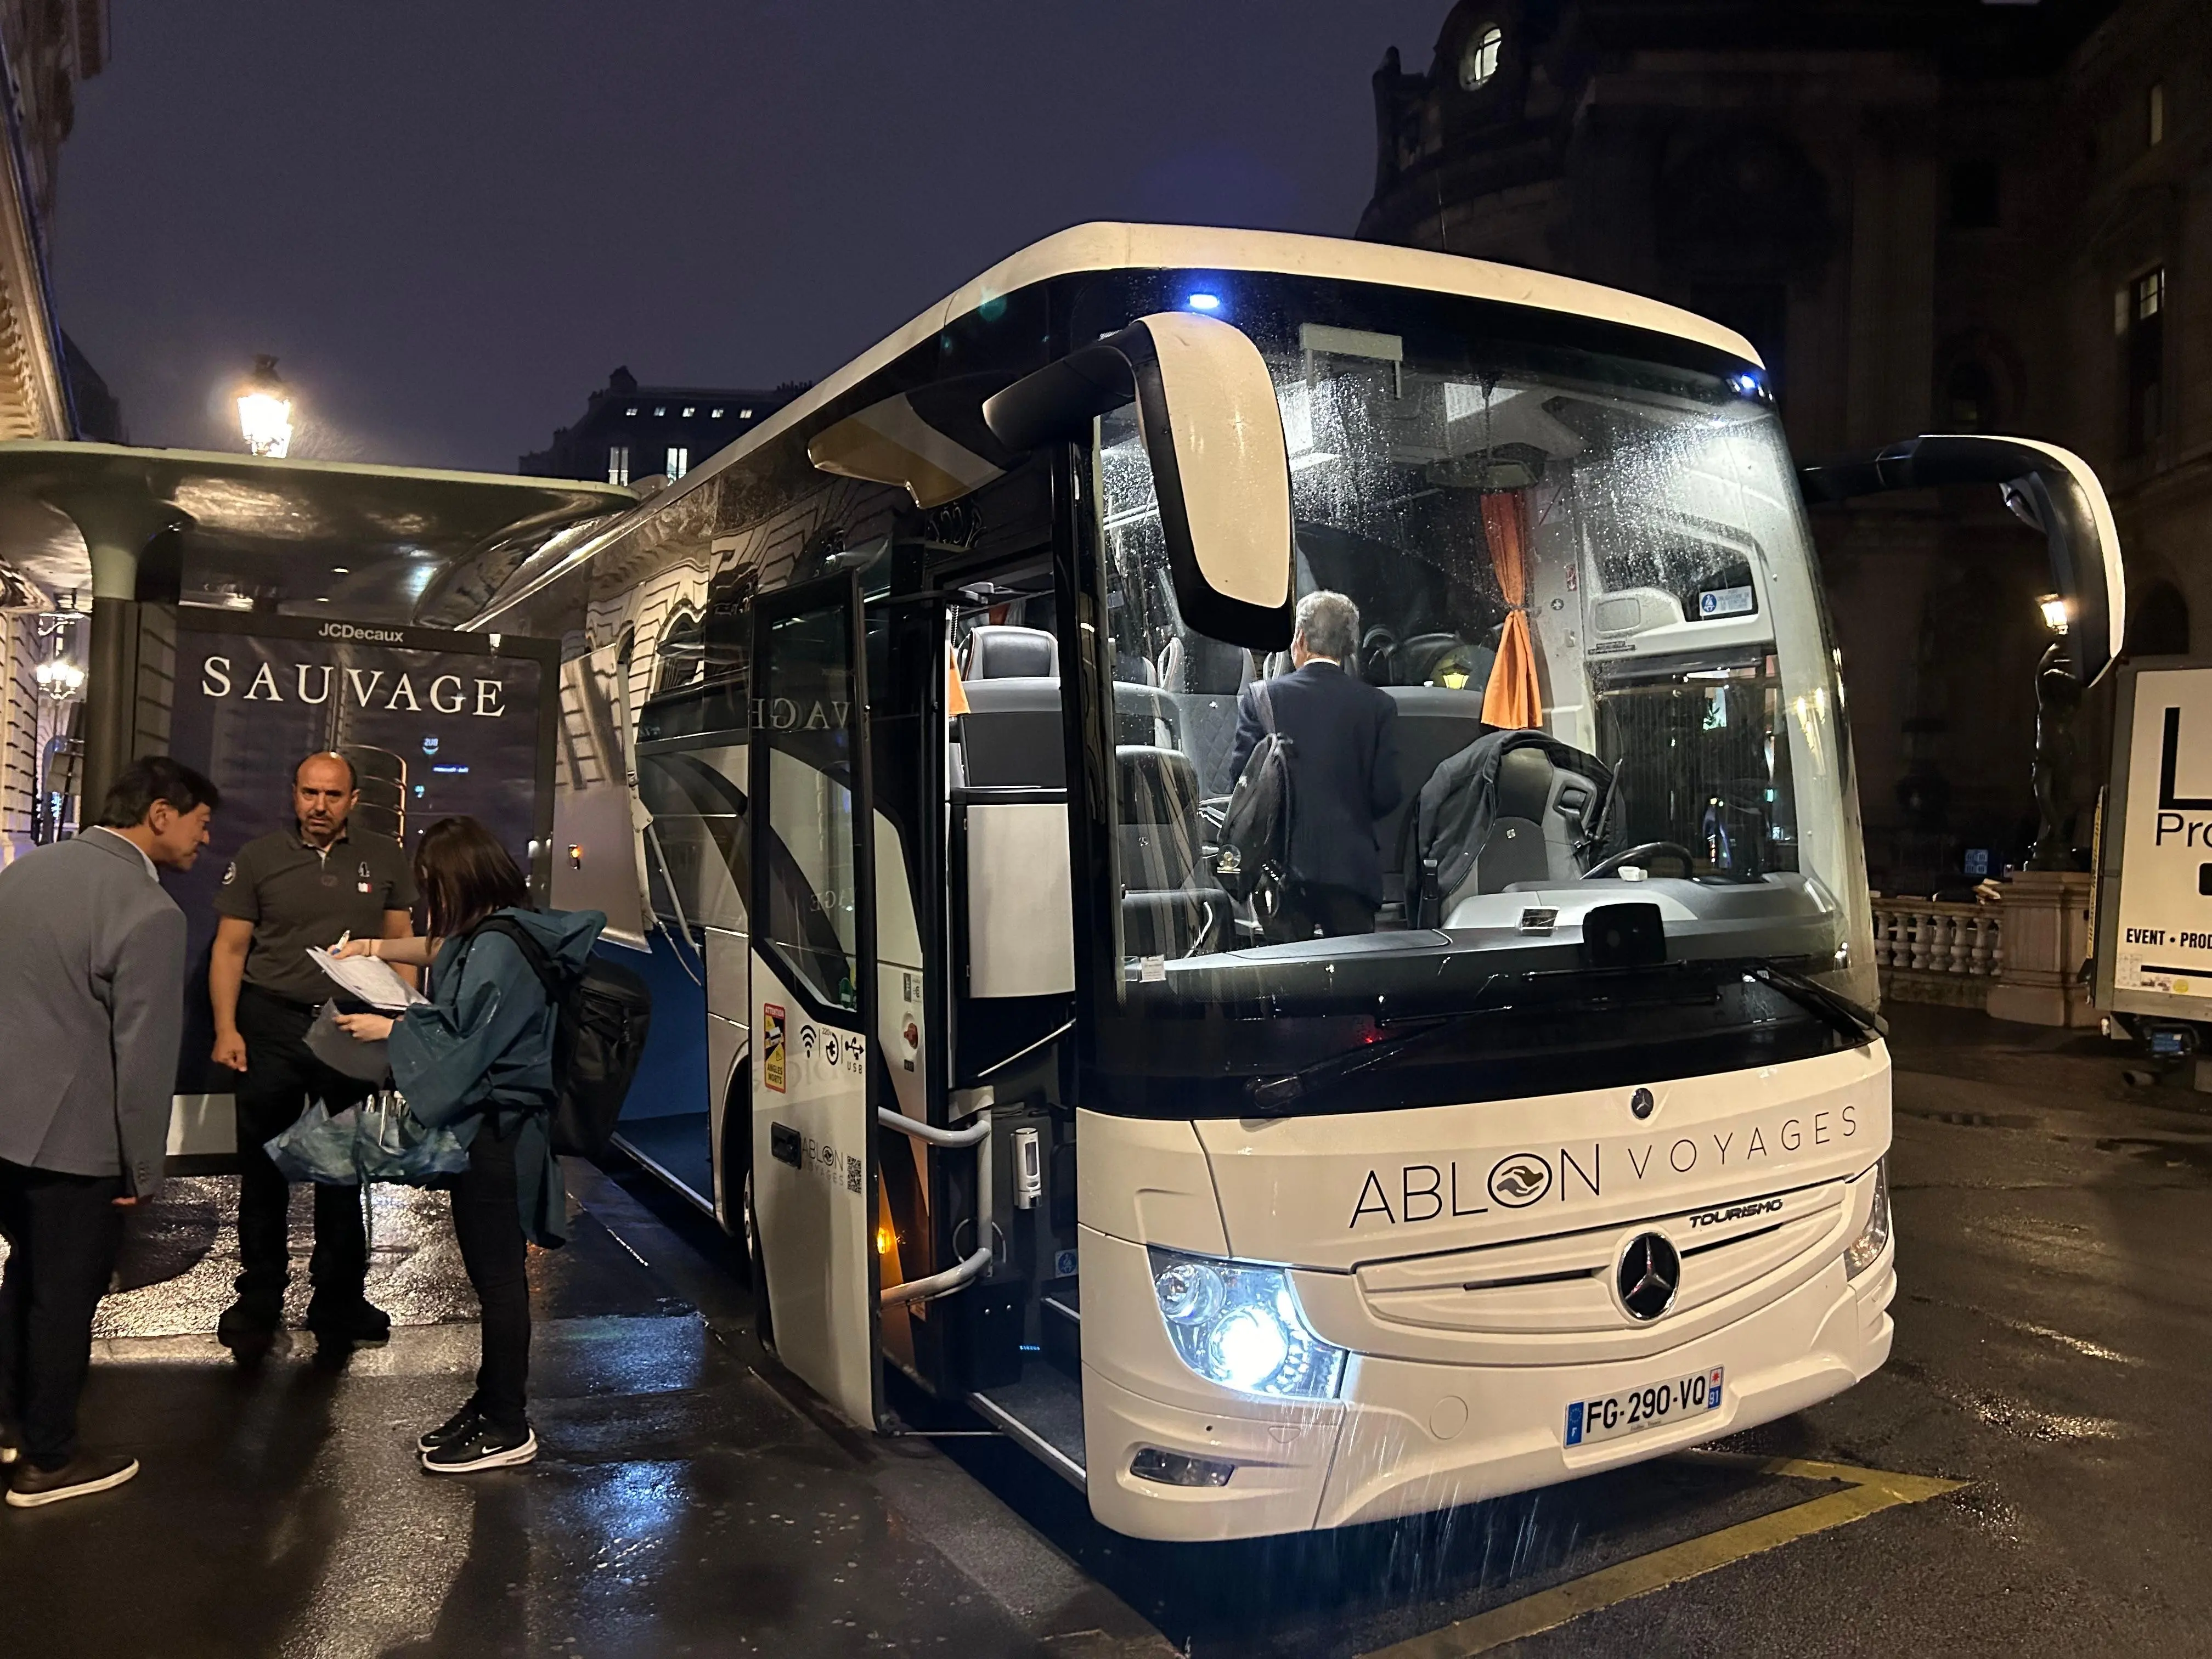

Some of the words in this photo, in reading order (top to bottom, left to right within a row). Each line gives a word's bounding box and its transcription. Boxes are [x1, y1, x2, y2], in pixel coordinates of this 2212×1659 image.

[318, 623, 404, 643] JCDecaux
[201, 656, 505, 717] SAUVAGE
[2126, 928, 2166, 945] EVENT
[768, 1063, 783, 1075] ANGLES
[768, 1073, 782, 1085] MORTS
[847, 1061, 862, 1074] USB
[802, 1137, 843, 1172] ABLON
[1348, 1143, 1600, 1229] ABLON
[1628, 1105, 1856, 1180] VOYAGES
[1689, 1198, 1784, 1228] TOURISMO
[1571, 1427, 1577, 1437] F
[1586, 1375, 1706, 1434] FG-290-VQ
[1708, 1389, 1719, 1406] 91
